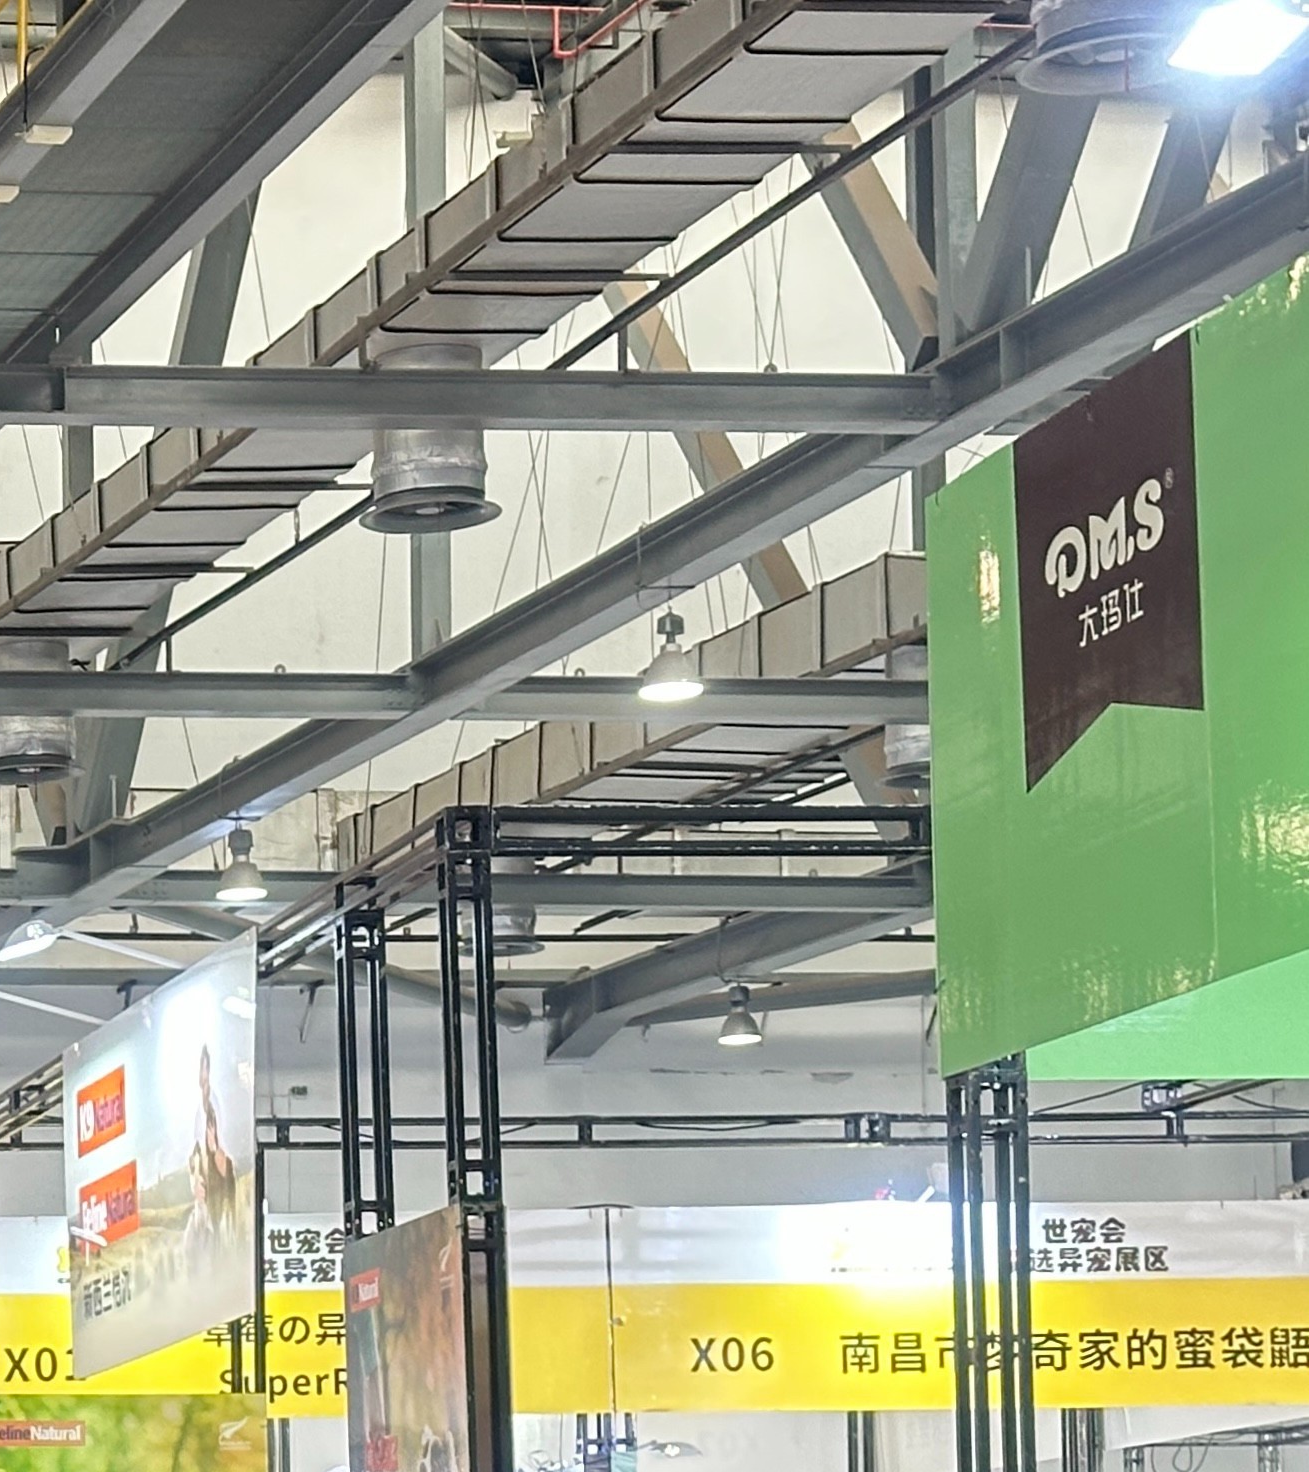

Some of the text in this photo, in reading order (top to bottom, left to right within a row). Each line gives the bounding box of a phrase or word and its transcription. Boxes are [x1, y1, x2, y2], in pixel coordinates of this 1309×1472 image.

[1042, 1218, 1126, 1244] 世宠会
[263, 1256, 345, 1283] 选异宠
[1009, 1246, 1168, 1272] 选异宠展区
[4, 1347, 86, 1382] X0
[690, 1337, 774, 1372] X06
